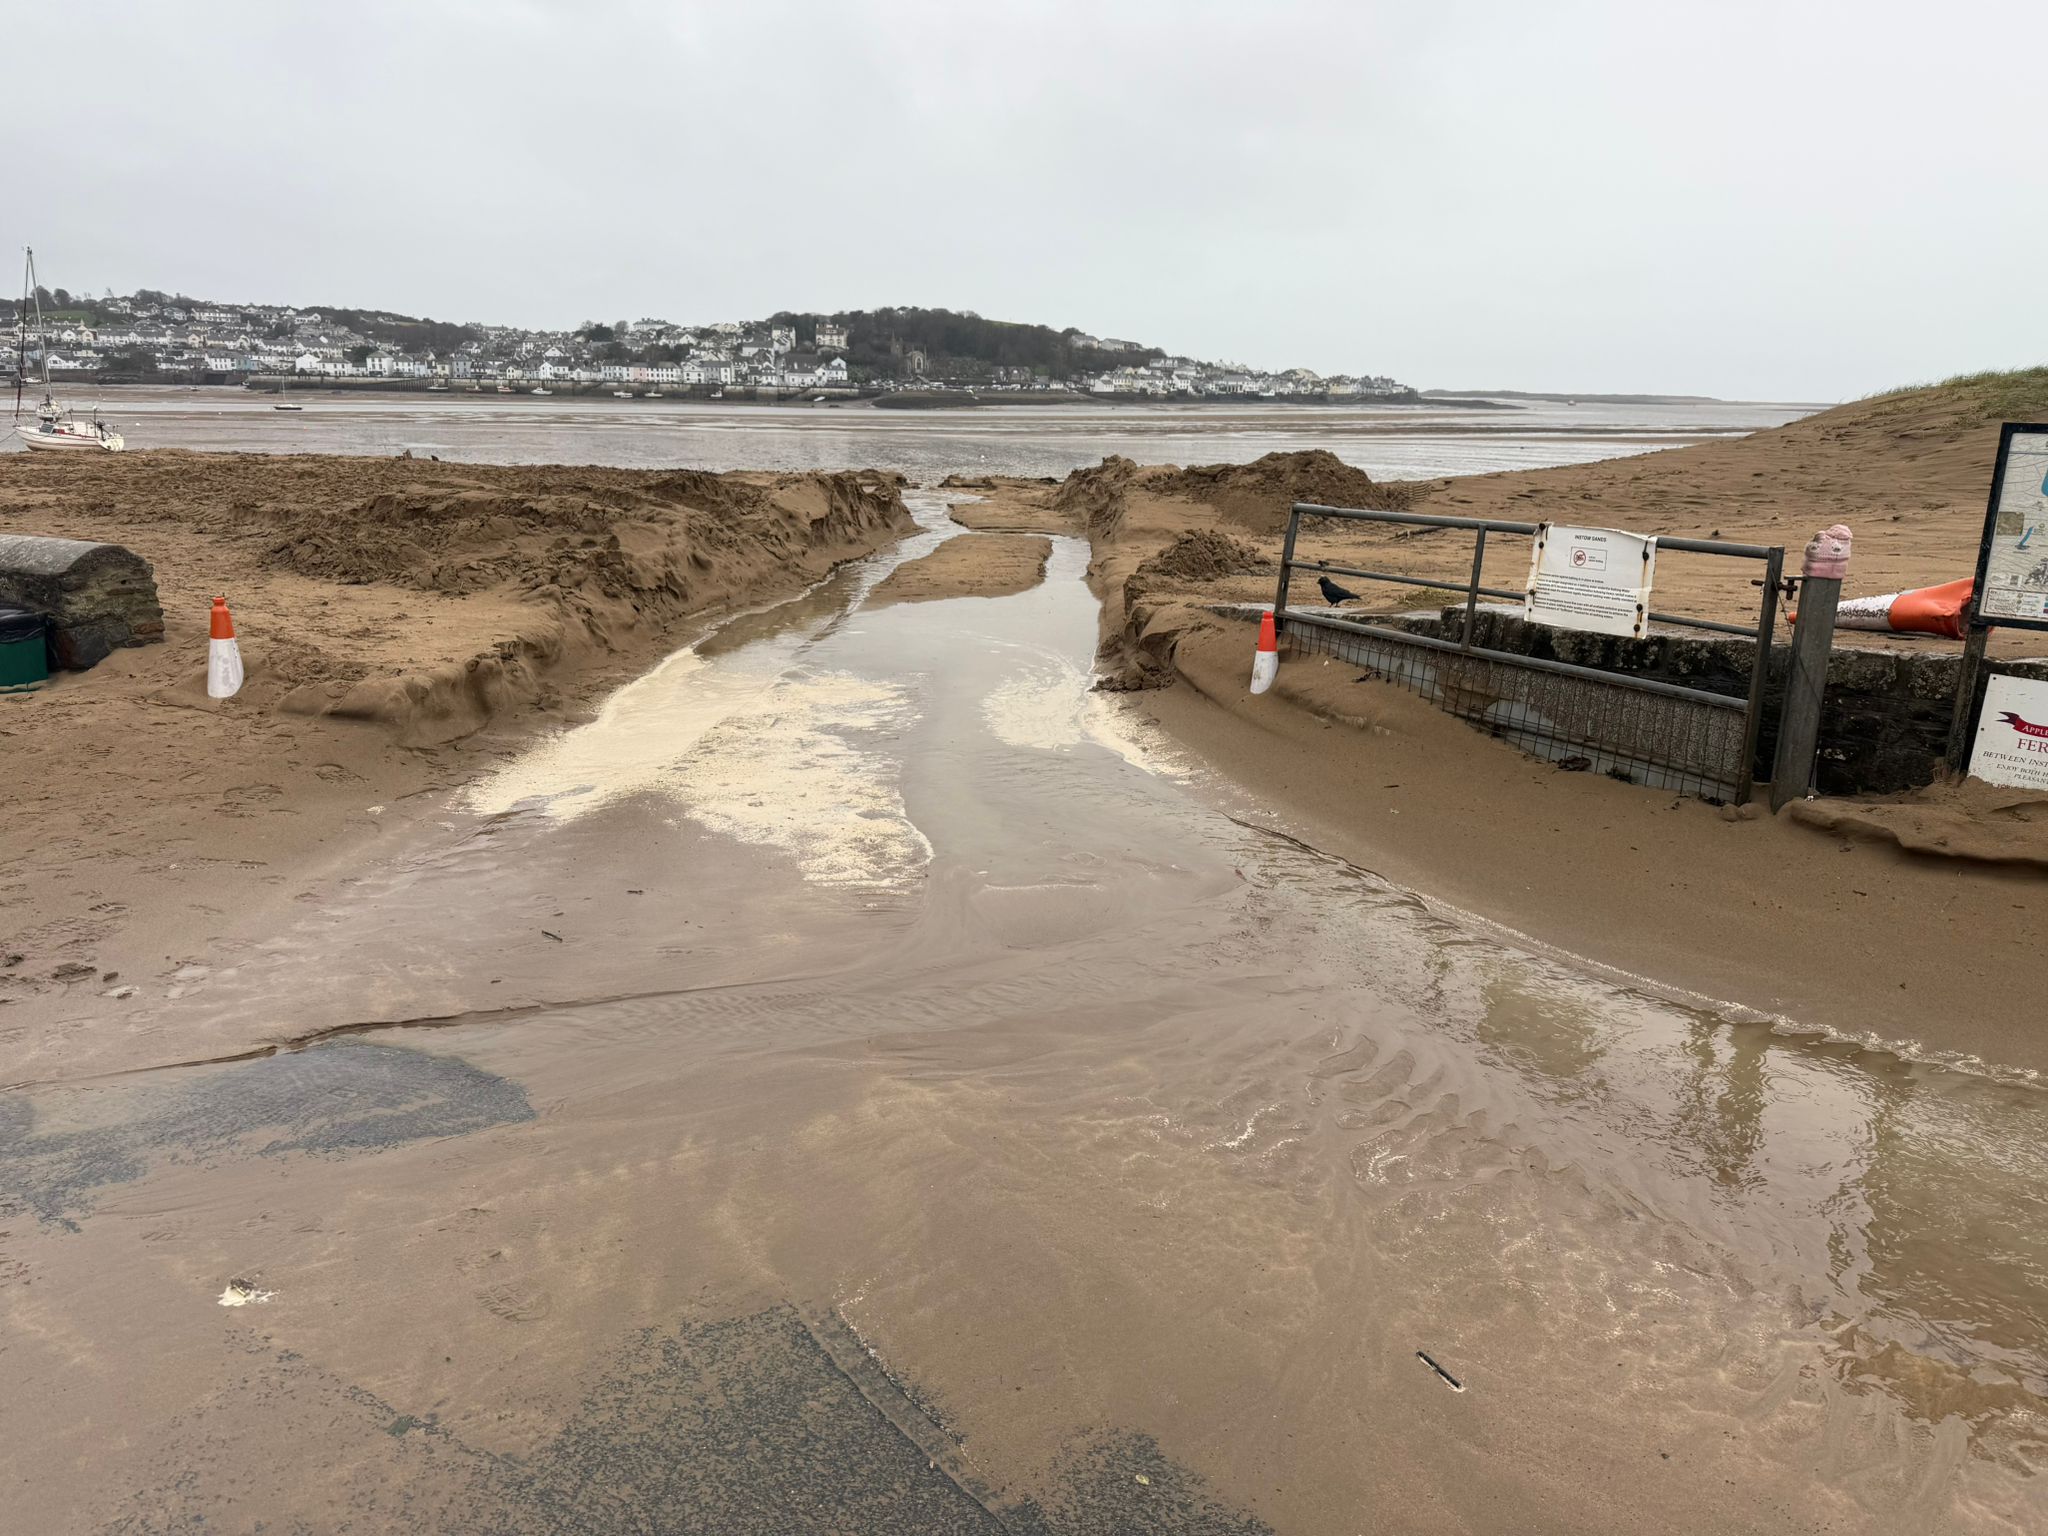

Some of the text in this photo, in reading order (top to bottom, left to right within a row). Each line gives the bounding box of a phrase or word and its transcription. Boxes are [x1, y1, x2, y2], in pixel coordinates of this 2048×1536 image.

[2017, 738, 2048, 753] FER
[1983, 750, 2026, 763] BETWEEN
[1997, 763, 2018, 771] ENJOY
